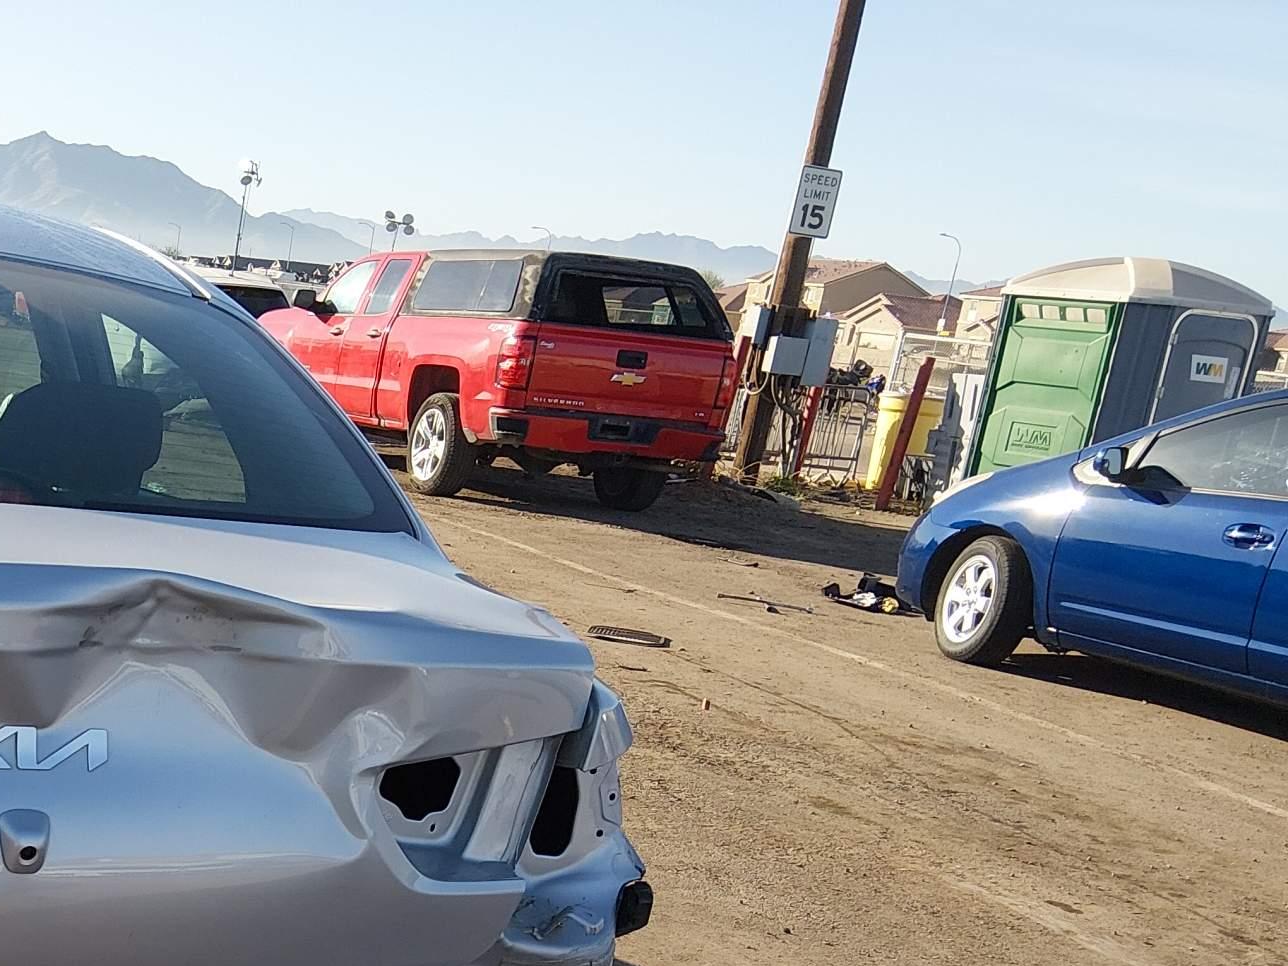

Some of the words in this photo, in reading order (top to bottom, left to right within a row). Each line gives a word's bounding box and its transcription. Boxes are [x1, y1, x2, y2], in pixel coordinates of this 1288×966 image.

[804, 173, 838, 188] SPEED
[804, 188, 831, 201] LIMIT
[800, 203, 825, 230] 15
[1195, 362, 1224, 377] WM
